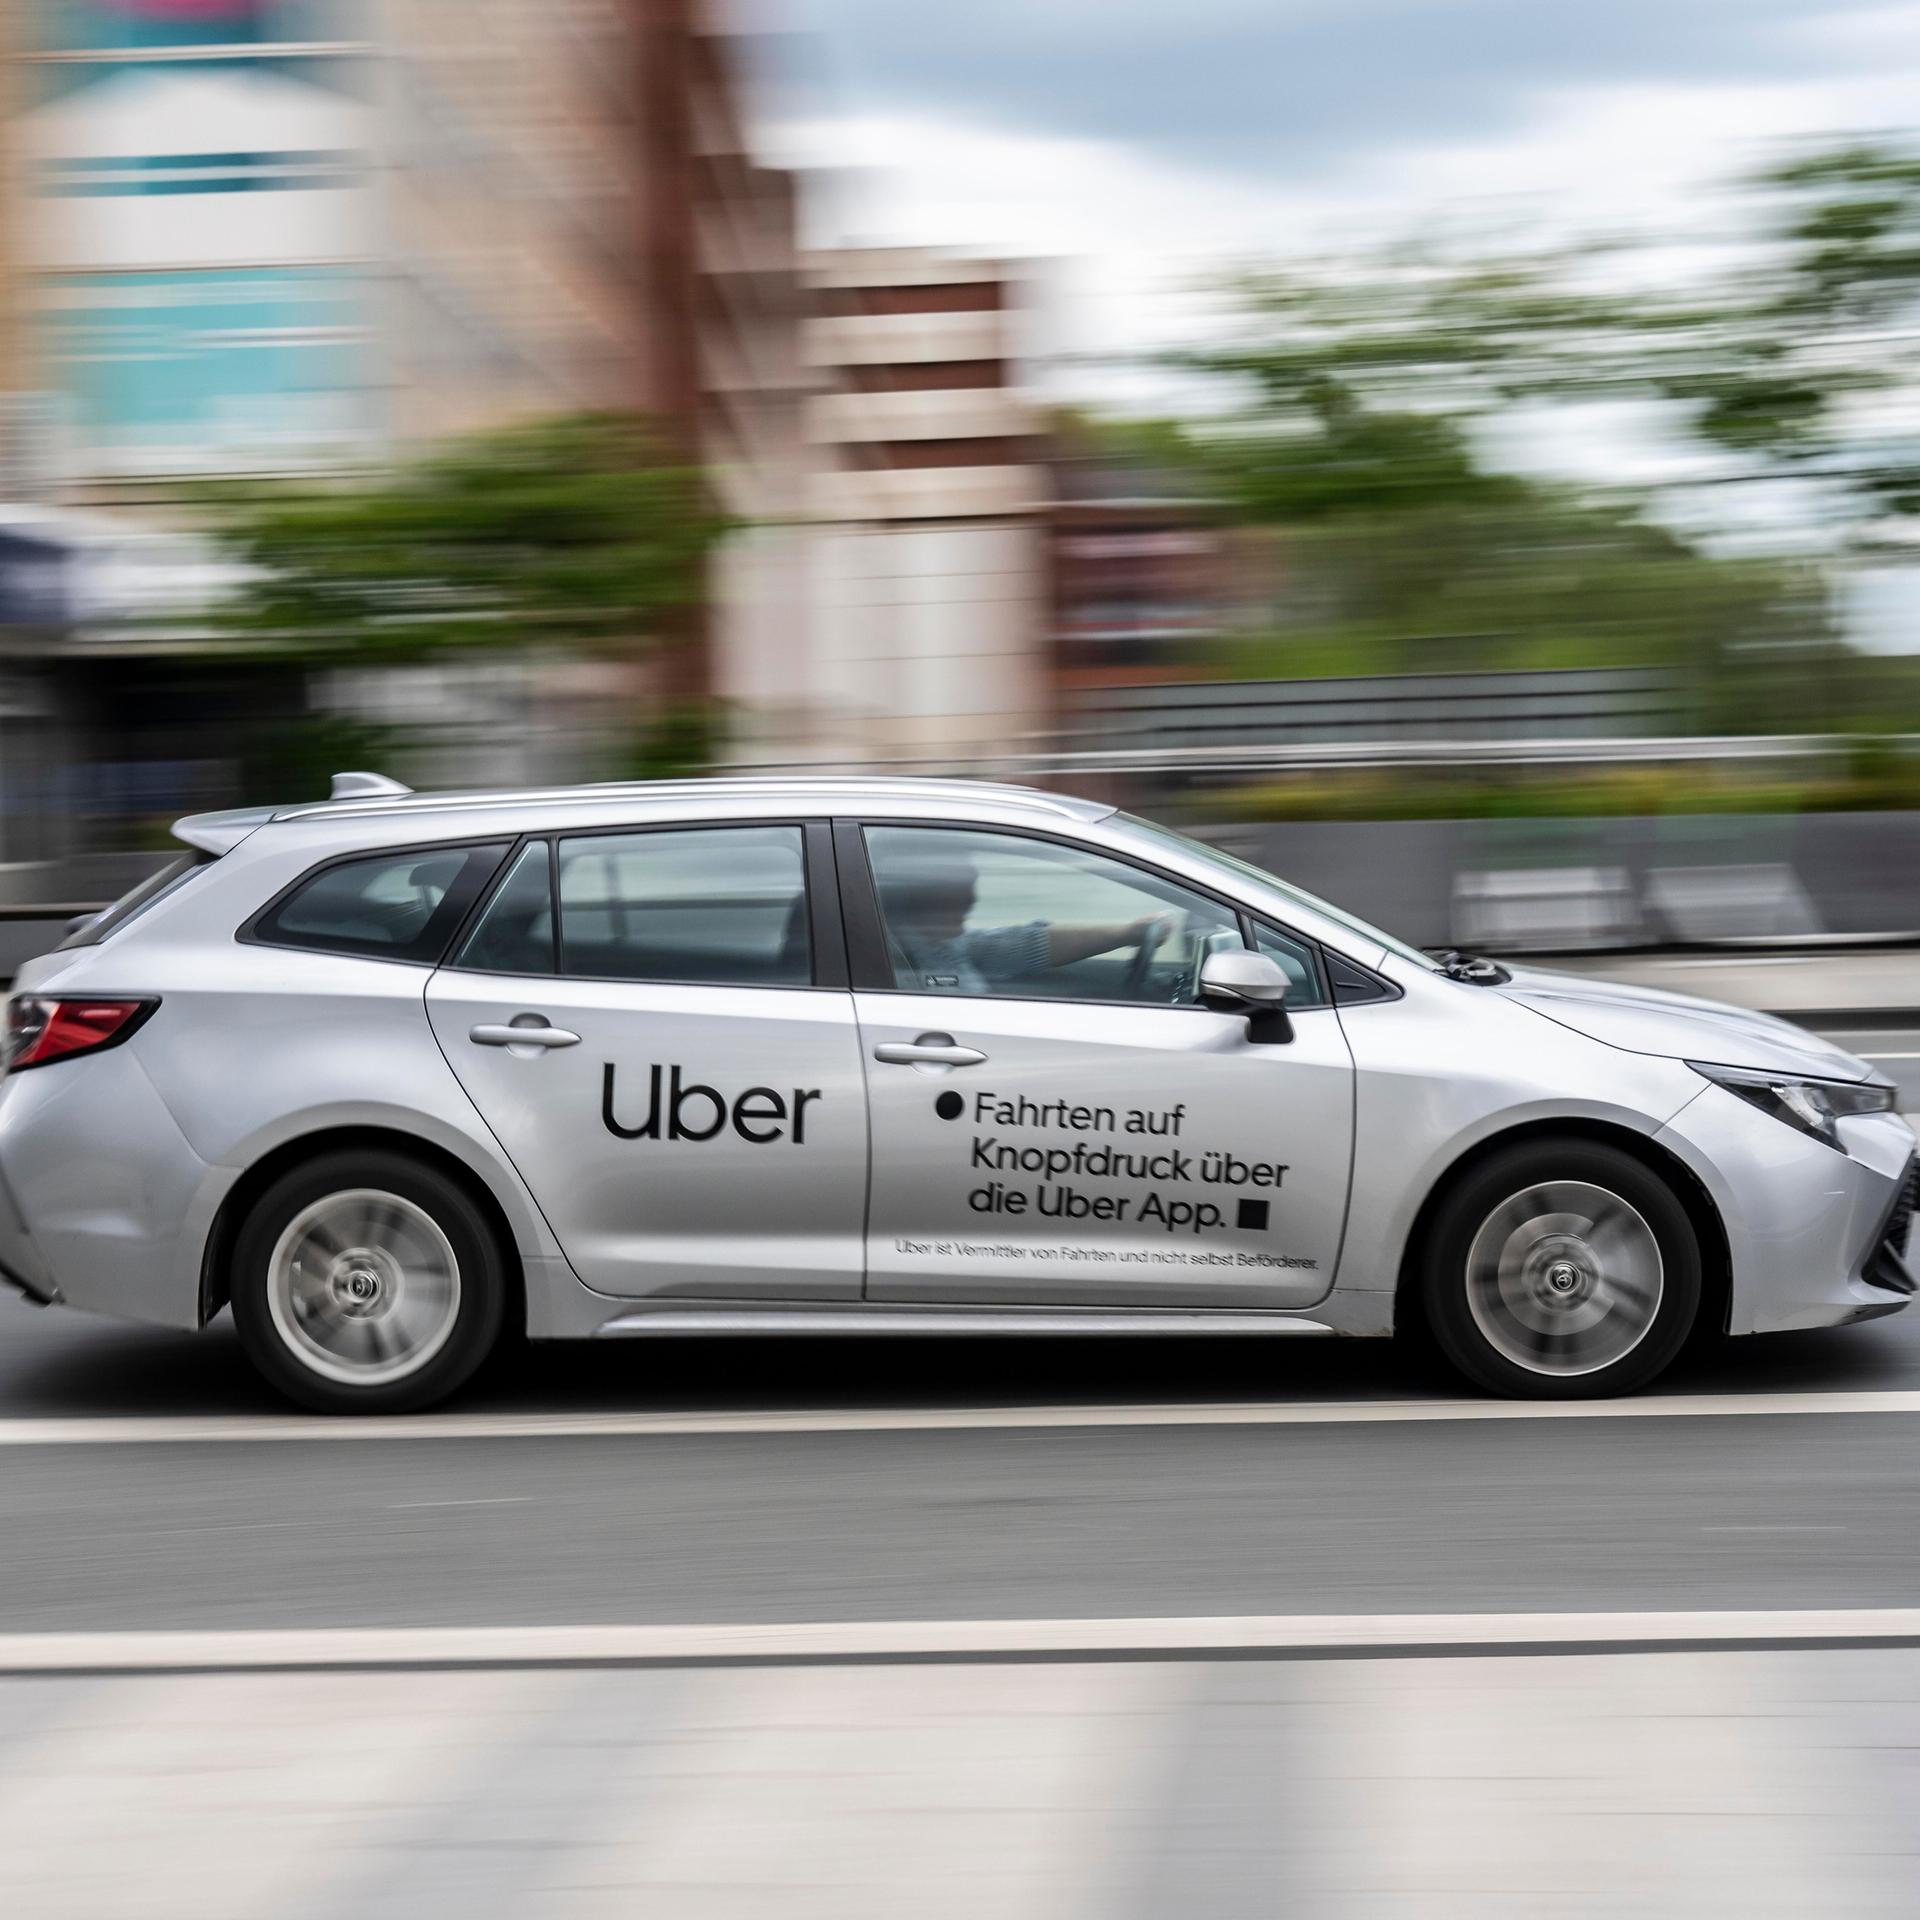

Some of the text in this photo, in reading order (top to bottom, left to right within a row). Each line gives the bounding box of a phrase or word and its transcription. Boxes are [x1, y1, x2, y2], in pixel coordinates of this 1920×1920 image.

[601, 1062, 822, 1145] Uber
[974, 1091, 1187, 1137] Fahrten auf
[970, 1136, 1291, 1188] Knopfdruck über
[968, 1181, 1227, 1234] die Uber App.
[895, 1239, 1320, 1271] Uber ist Vermittler von Fahrten und nicht selbst Beförderer.
